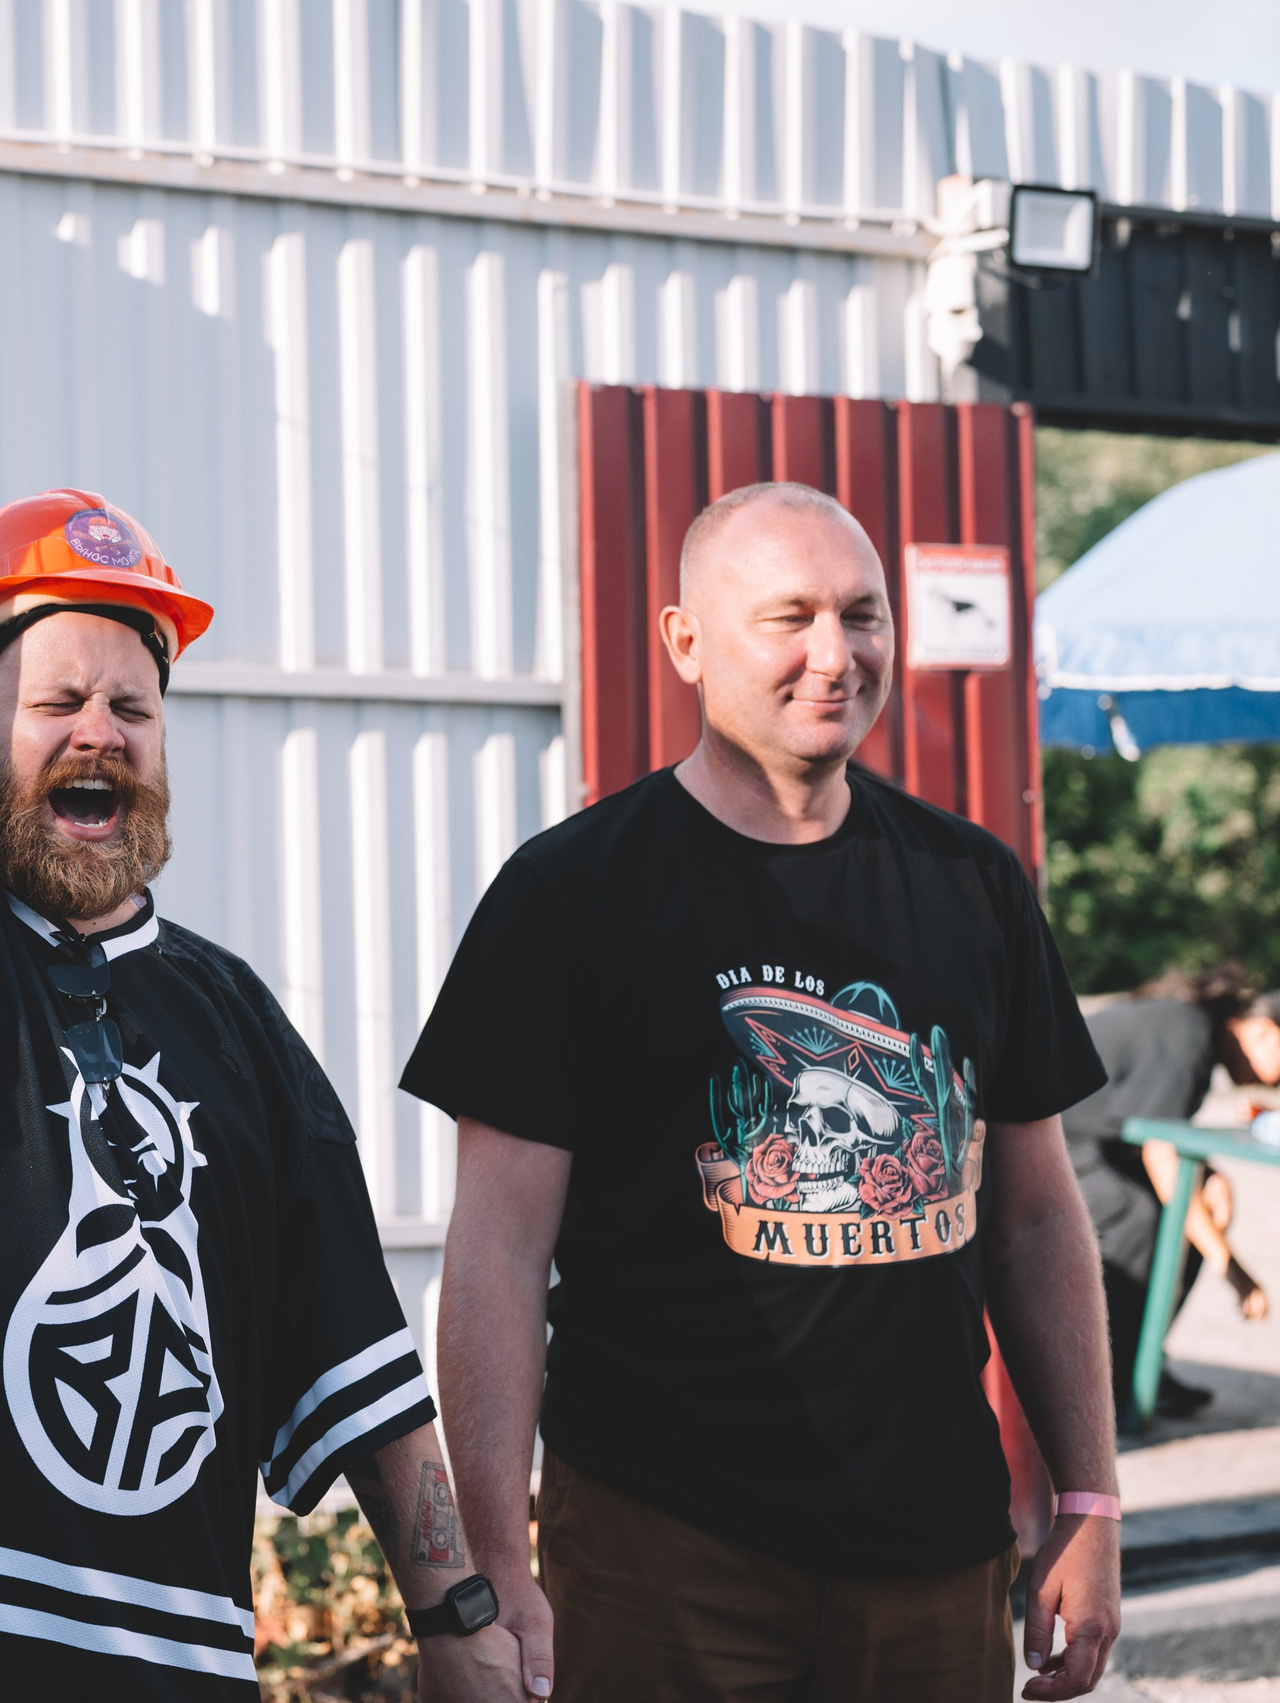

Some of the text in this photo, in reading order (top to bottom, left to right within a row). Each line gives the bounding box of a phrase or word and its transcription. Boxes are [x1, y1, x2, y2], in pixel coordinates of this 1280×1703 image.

[716, 964, 826, 996] DIA DE LOS
[752, 1203, 967, 1258] MUERTOS
